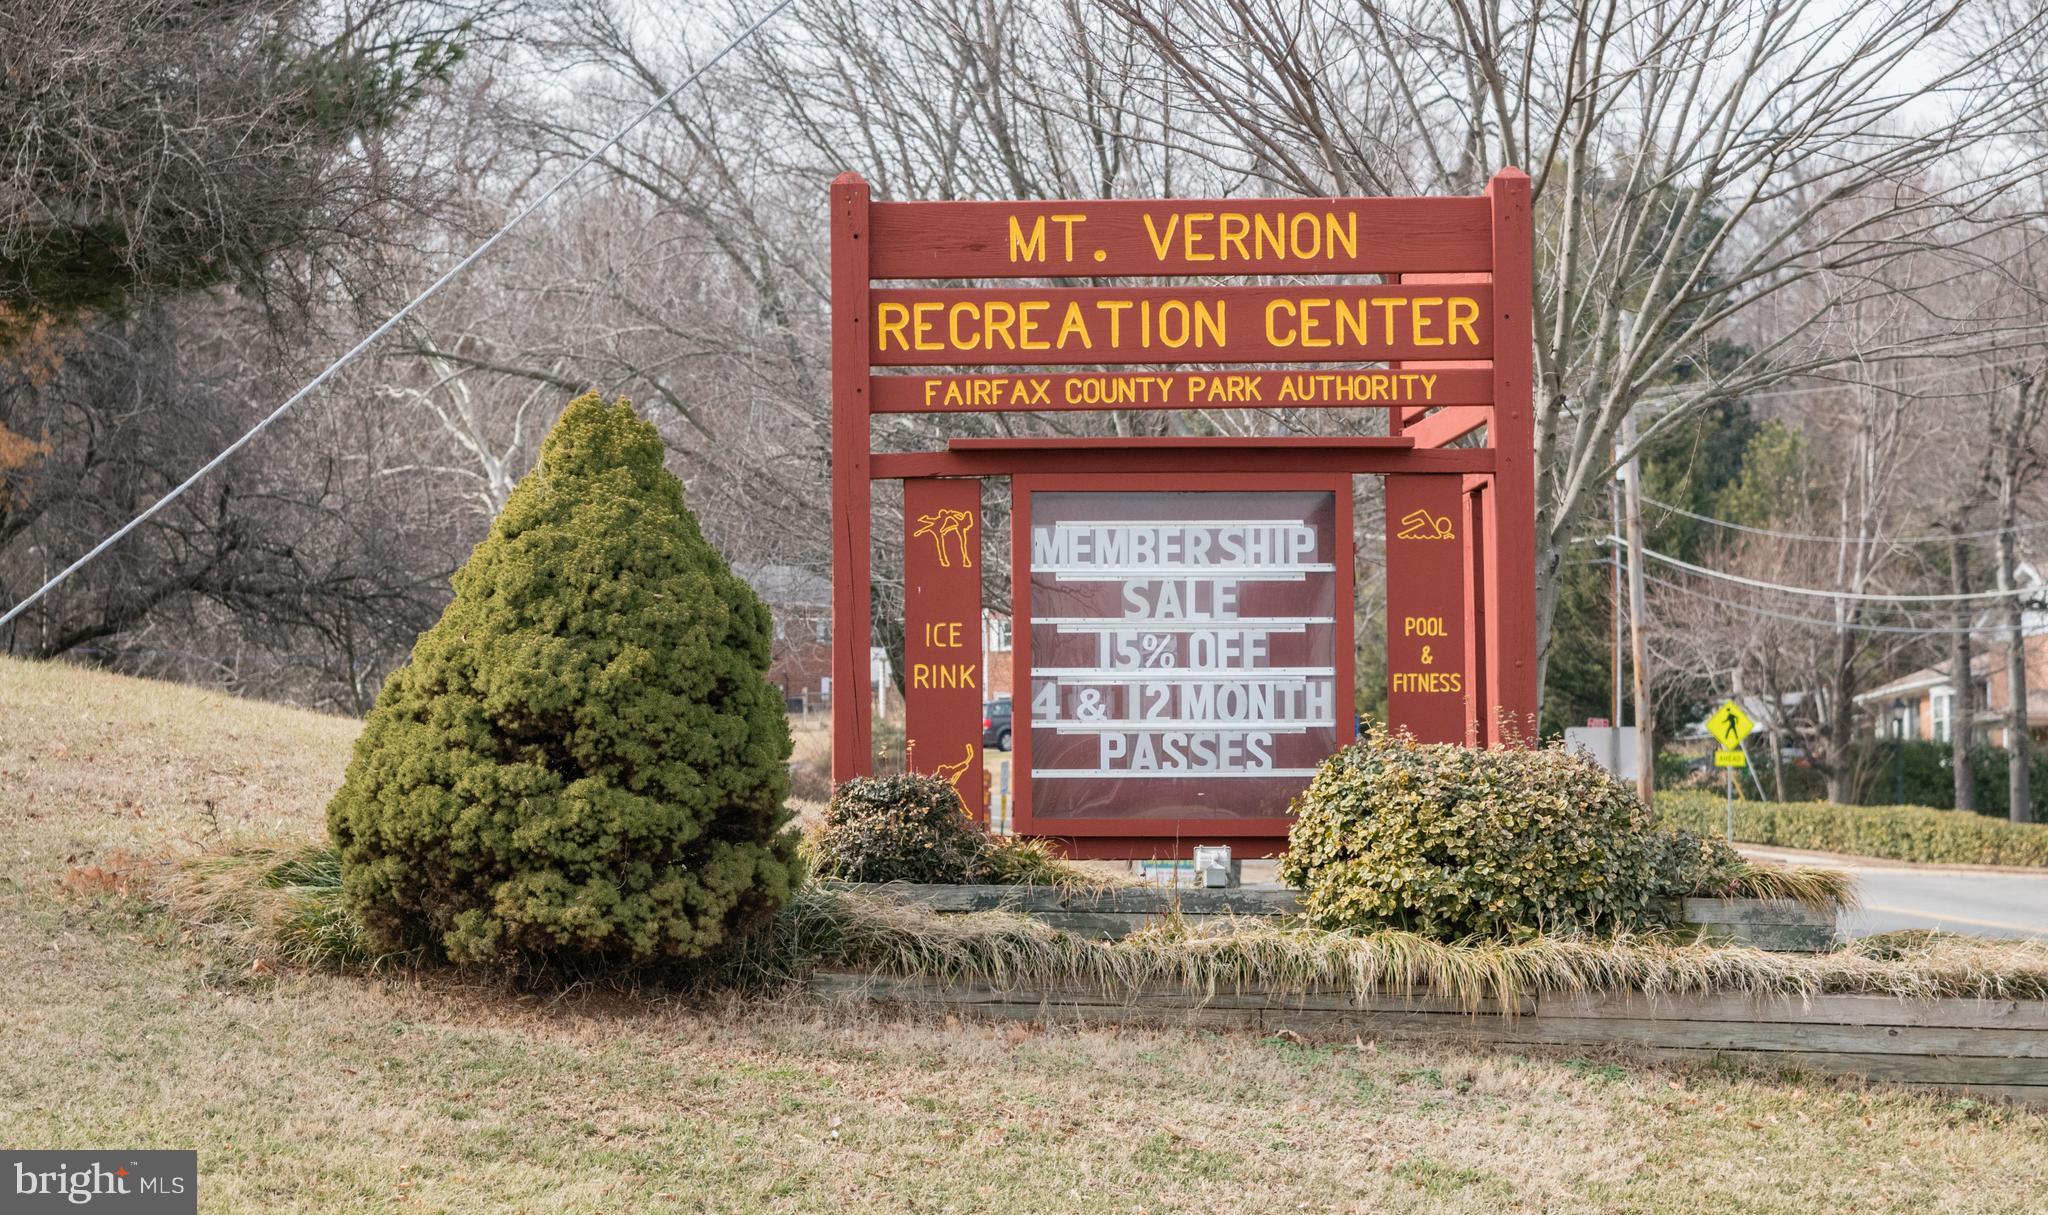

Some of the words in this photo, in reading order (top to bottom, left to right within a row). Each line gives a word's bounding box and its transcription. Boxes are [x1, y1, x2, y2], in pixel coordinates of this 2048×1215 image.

[1008, 213, 1107, 263] MT.
[1143, 211, 1358, 262] VERNON
[878, 300, 1227, 352] RECREATION
[1265, 296, 1480, 349] CENTER
[924, 378, 1051, 406] FAIRFAX
[1064, 376, 1173, 405] COUNTY
[1187, 375, 1263, 402] PARK
[1278, 373, 1437, 402] AUTHORITY
[1034, 527, 1314, 567] MEMBERSHIP
[1123, 580, 1237, 618] SALE
[925, 622, 963, 648] ICE
[1404, 616, 1448, 637] POOL
[1100, 631, 1176, 671] 15%
[1189, 631, 1266, 671] OFF
[1420, 645, 1434, 665] &
[913, 664, 977, 689] RINK
[1392, 672, 1462, 693] FITNESS
[1032, 682, 1060, 721] 4
[1076, 688, 1108, 721] &
[1128, 683, 1171, 721] 12
[1180, 682, 1332, 721] MONTH
[1100, 732, 1273, 771] PASSES
